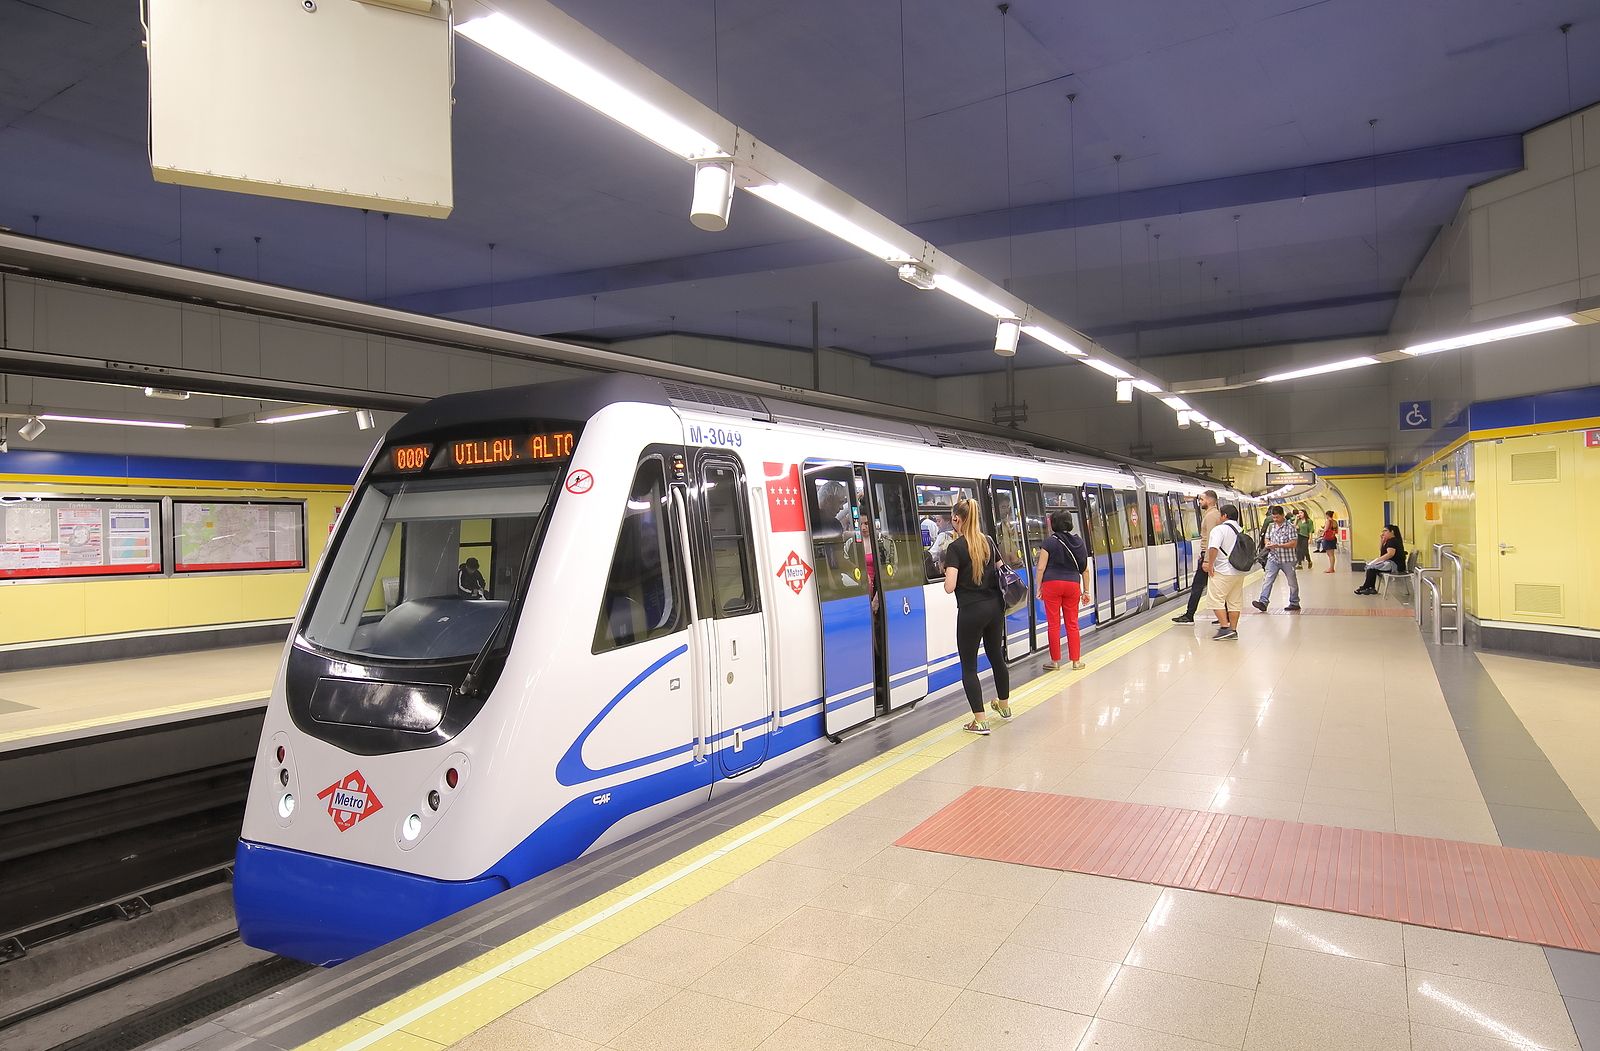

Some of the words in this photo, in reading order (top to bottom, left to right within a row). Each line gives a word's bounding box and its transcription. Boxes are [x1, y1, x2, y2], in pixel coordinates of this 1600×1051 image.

[690, 426, 742, 447] M-3049
[455, 439, 520, 465] VILLAV.
[532, 433, 574, 459] ALTO
[335, 793, 364, 809] Metro
[593, 793, 611, 805] CAF
